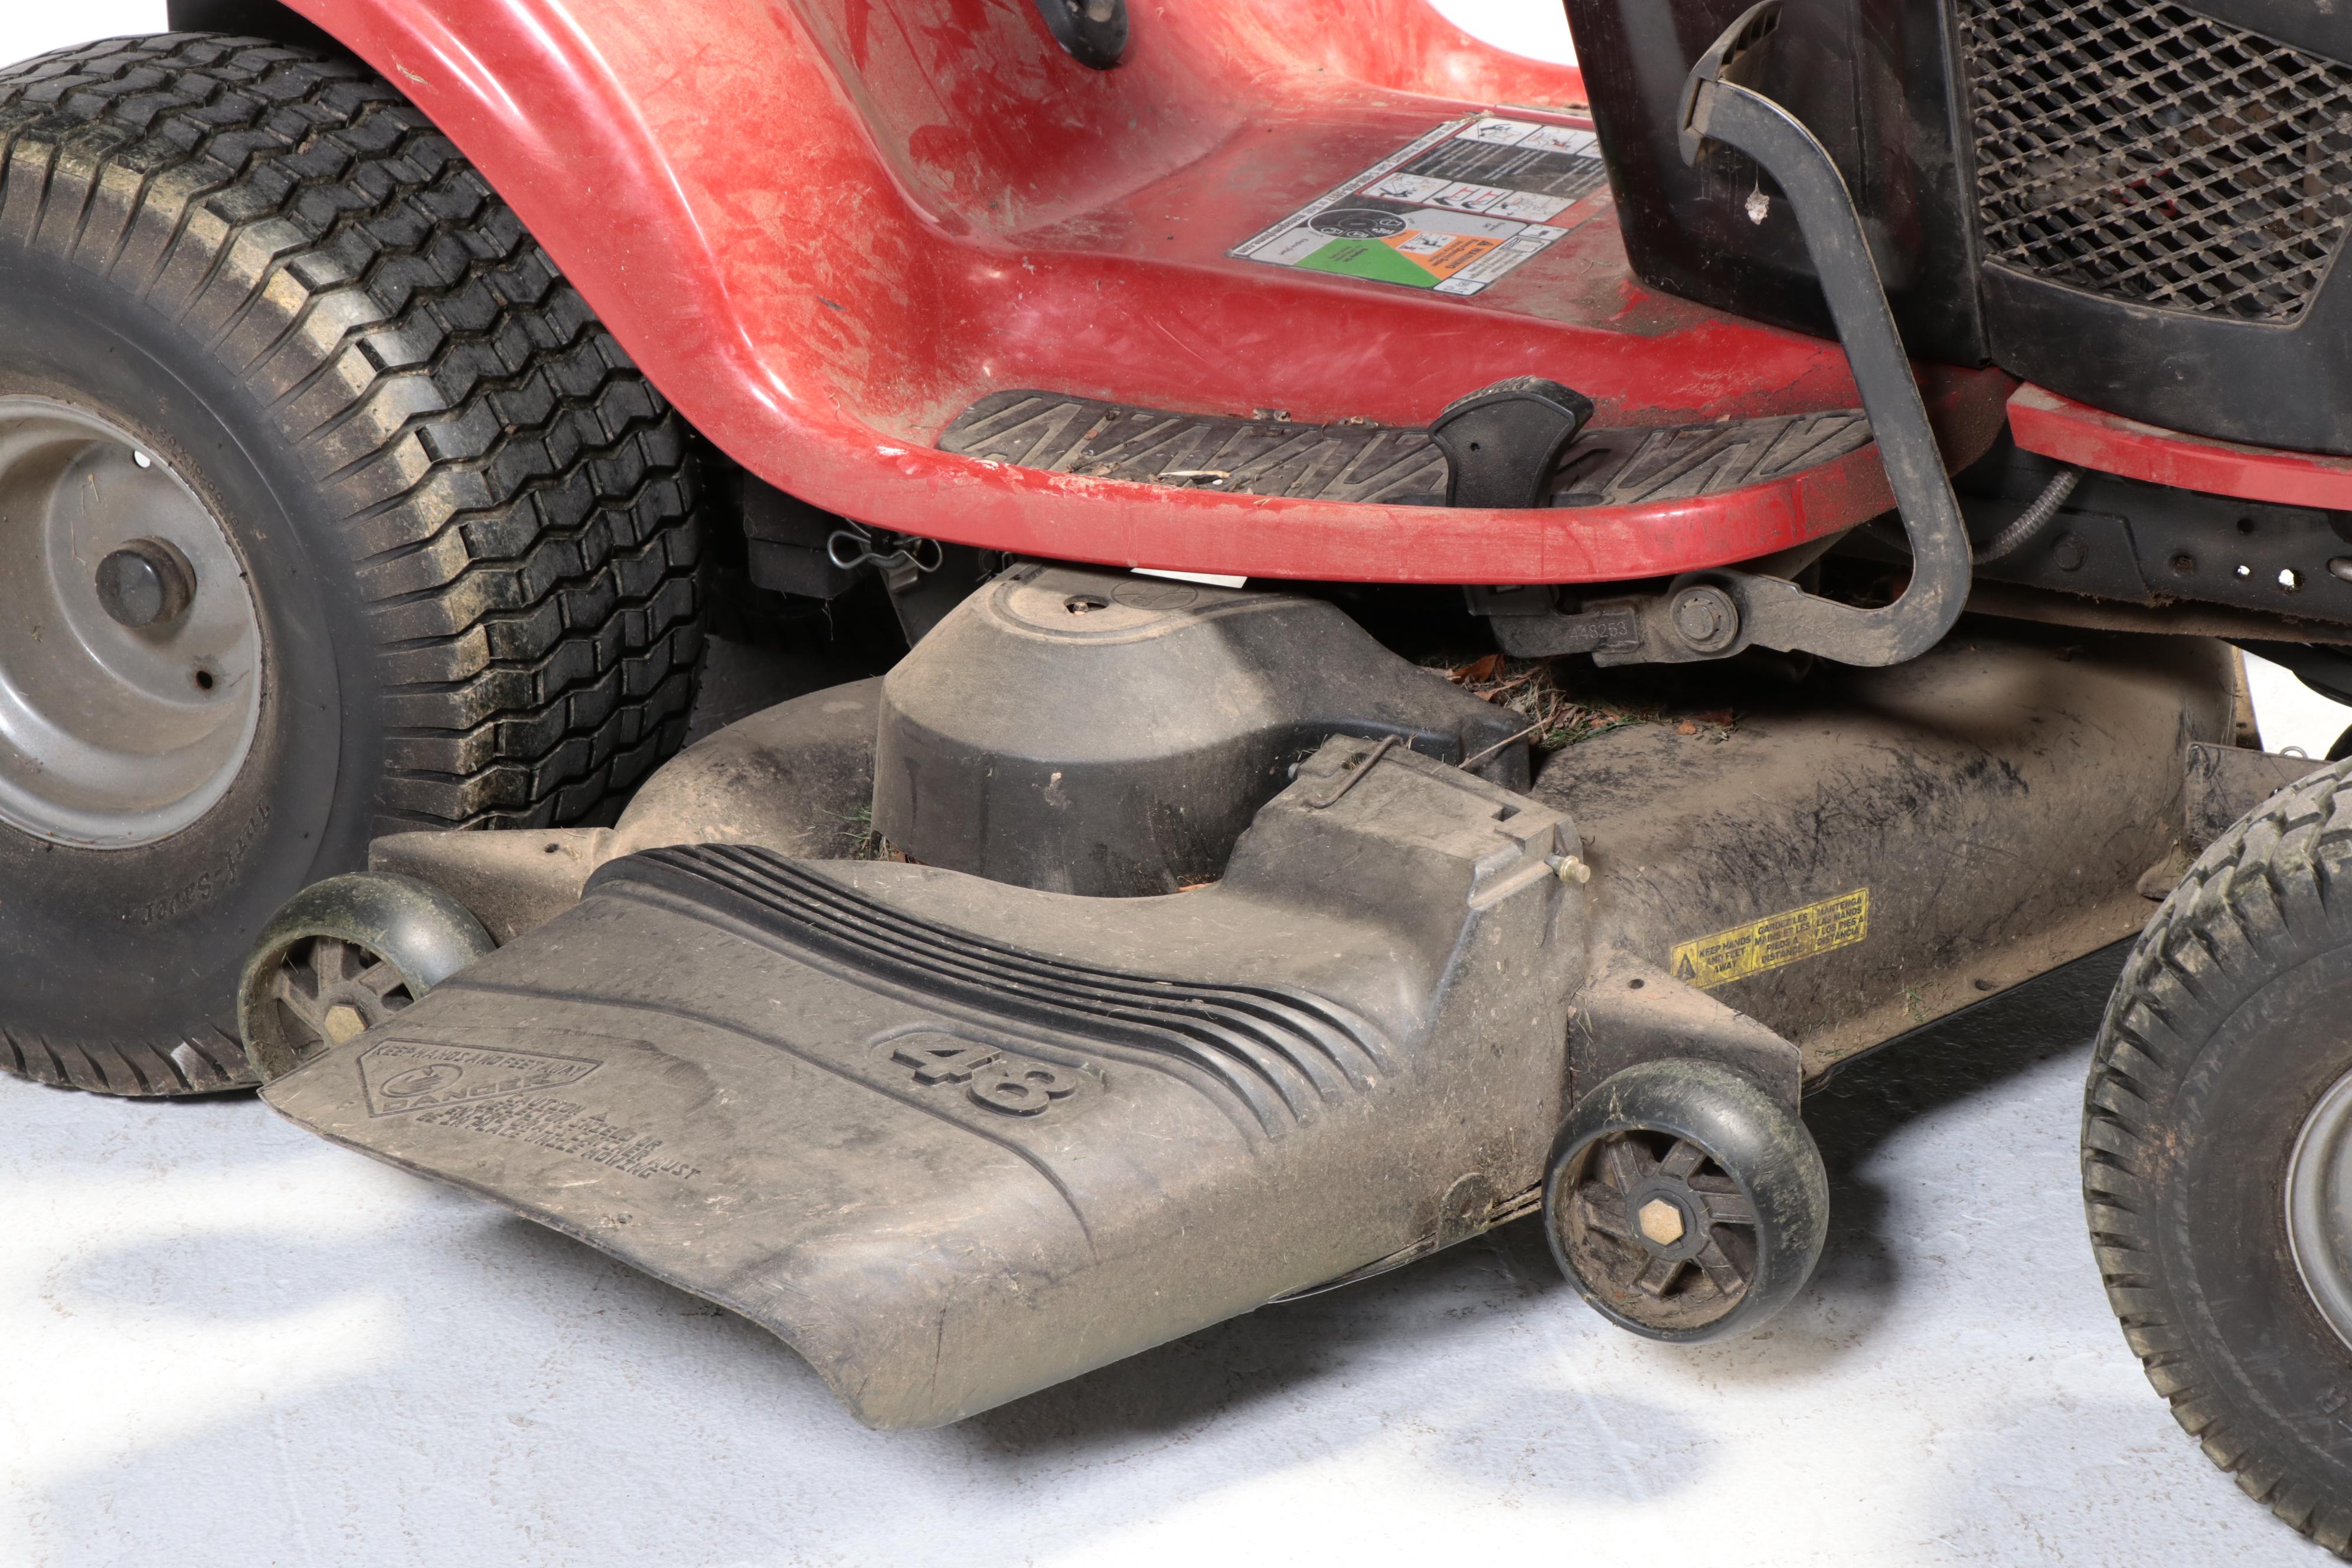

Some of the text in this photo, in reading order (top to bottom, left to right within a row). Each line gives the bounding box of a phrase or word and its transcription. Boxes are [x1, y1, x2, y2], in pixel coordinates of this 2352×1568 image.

[1233, 214, 1308, 253] managemyhome.com
[1443, 247, 1484, 269] WARNING
[1570, 621, 1628, 639] 448253
[1817, 906, 1861, 926] LAS MANOS
[1818, 897, 1861, 915] MANTENGA
[1755, 922, 1810, 945] MAINS ET LES
[1759, 913, 1807, 935] GARDEZ LES
[1822, 924, 1837, 933] LOS
[1839, 917, 1856, 928] PIES
[1700, 936, 1750, 958] KEEP HANDS
[1767, 939, 1790, 950] PIEDS
[1818, 927, 1858, 945] DISTANCIA
[1707, 947, 1745, 965] AND FEET
[1762, 945, 1802, 963] DISTANCE
[1714, 961, 1736, 973] AWAY
[372, 1044, 587, 1076] KEEP HANDS AND FEET AWAY
[891, 1043, 1076, 1118] 48
[383, 1072, 551, 1112] DANGER
[506, 1093, 587, 1116] CAUTION
[475, 1099, 664, 1151] DEFLECTOR SHIELD OR
[415, 1111, 659, 1180] BE IN PLACE WHILE MOWING
[444, 1105, 701, 1180] ENTIRE GRASS CATCHER MUST
